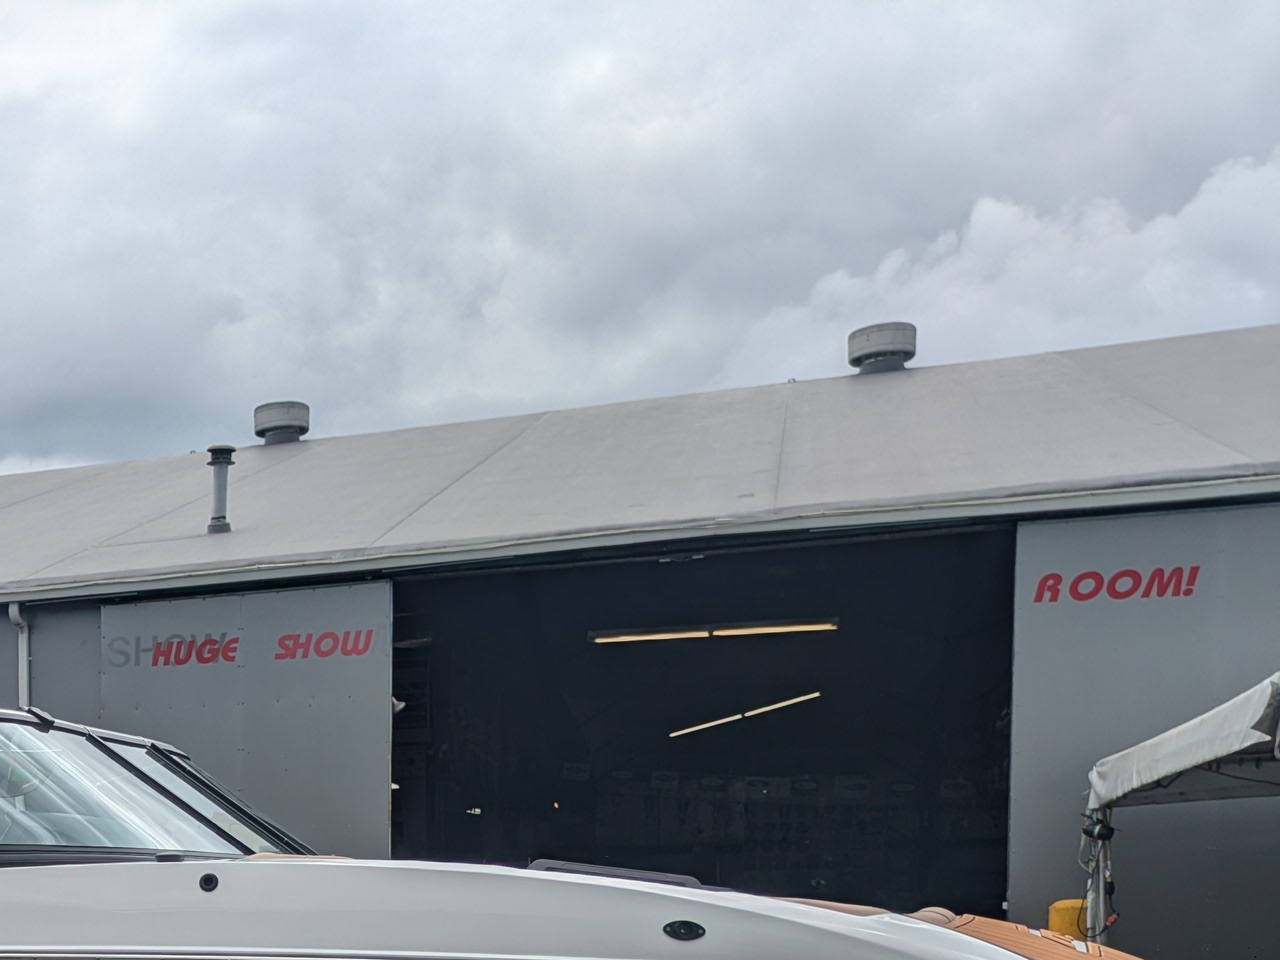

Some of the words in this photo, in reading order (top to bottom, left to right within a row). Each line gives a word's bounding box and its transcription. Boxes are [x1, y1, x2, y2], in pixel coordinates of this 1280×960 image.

[1033, 565, 1200, 603] ROOM!
[151, 637, 240, 667] HUGE
[274, 629, 374, 660] SHOW
